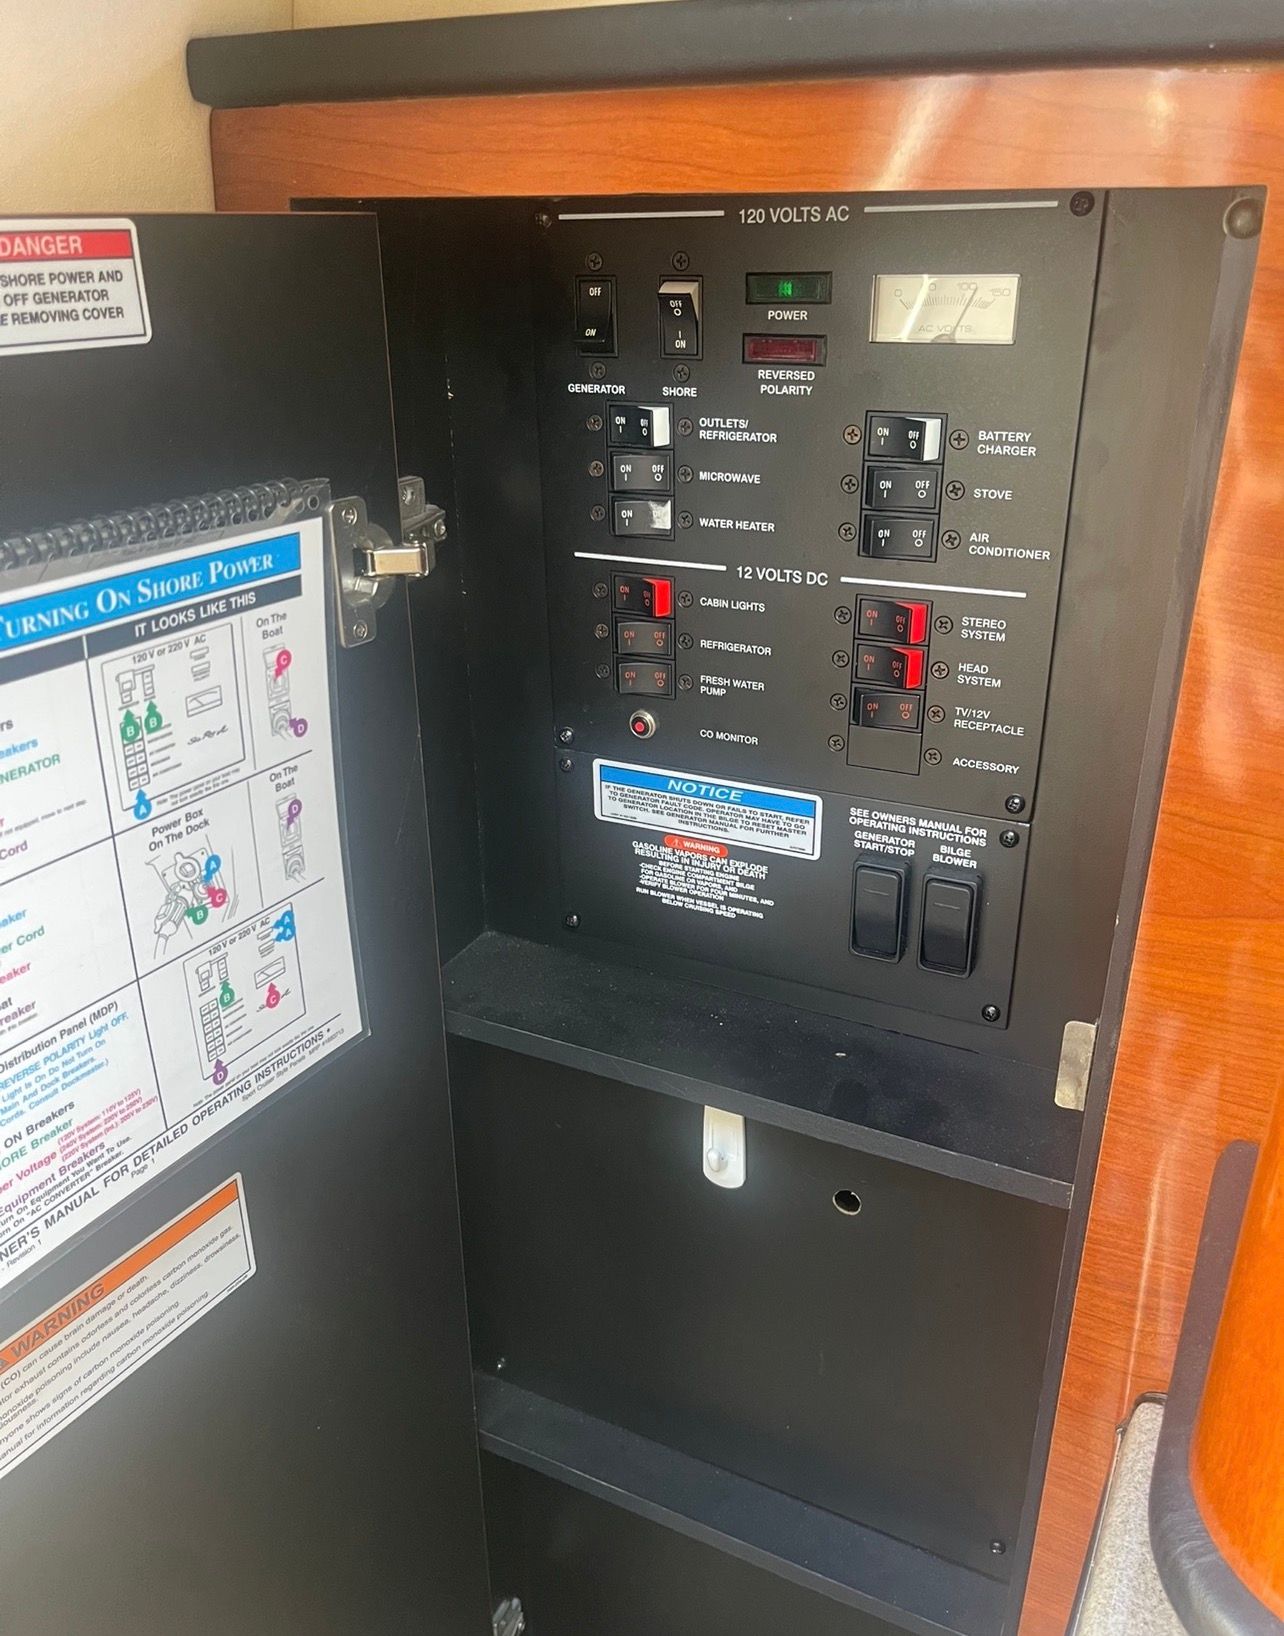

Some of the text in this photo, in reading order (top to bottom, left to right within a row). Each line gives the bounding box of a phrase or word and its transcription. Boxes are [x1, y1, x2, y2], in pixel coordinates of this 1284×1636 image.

[739, 206, 849, 224] 120 VOLTS AC
[0, 235, 83, 257] DANGER
[0, 270, 123, 287] SHORE POWER AND
[4, 289, 109, 306] OFF GENERATOR
[589, 287, 601, 296] OFF
[670, 300, 682, 308] OFF
[12, 311, 79, 325] REMOVING
[83, 307, 124, 320] COVER
[768, 310, 807, 321] POWER
[585, 329, 596, 337] ON
[675, 339, 686, 349] ON
[758, 370, 815, 381] REVERSED
[568, 383, 625, 394] GENERATOR
[662, 387, 697, 397] SHORE
[760, 385, 813, 395] POLARITY
[616, 417, 626, 425] ON
[700, 418, 748, 428] OUTLETS/
[700, 430, 777, 443] REFRIGERATOR
[877, 428, 919, 440] ON OFF
[979, 431, 1031, 442] BATTERY
[977, 444, 1036, 456] CHARGER
[620, 465, 664, 473] ON OFF
[700, 471, 761, 484] MICROWAVE
[880, 481, 929, 489] ON OFF
[973, 489, 1012, 500] STOVE
[622, 510, 632, 518] ON
[700, 518, 775, 532] WATER HEATER
[878, 530, 926, 538] ON OFF
[970, 533, 989, 542] AIR
[969, 546, 1050, 560] CONDITIONER
[737, 566, 828, 586] 12 VOLTS DC
[700, 597, 765, 612] CABIN LIGHTS
[135, 592, 257, 638] IT LOOKS LIKE THIS
[256, 613, 287, 628] On The
[867, 610, 905, 624] ON OFF
[962, 616, 1006, 630] STEREO
[262, 626, 284, 640] Boat
[961, 629, 1005, 642] SYSTEM
[132, 654, 147, 664] 120
[157, 648, 166, 656] or
[168, 641, 183, 653] 220
[194, 634, 206, 645] AC
[700, 640, 772, 656] REFRIGERATOR
[864, 655, 874, 663] ON
[959, 663, 988, 674] HEAD
[700, 675, 764, 691] FRESH WATER
[957, 675, 1001, 688] SYSTEM
[700, 686, 726, 696] PUMP
[867, 703, 912, 711] ON OFF
[955, 707, 990, 719] TV/12V
[954, 719, 1024, 736] RECEPTACLE
[700, 729, 758, 745] CO MONITOR
[269, 765, 298, 782] On The
[953, 758, 1019, 774] ACCESSORY
[275, 777, 295, 792] Boat
[667, 779, 744, 802] NOTICE
[627, 788, 667, 799] GENERATOR
[669, 796, 691, 804] SHUTS
[693, 800, 714, 808] DOWN
[728, 804, 747, 814] FAILS
[786, 816, 809, 824] REFER
[151, 808, 204, 837] Power Box
[850, 808, 987, 837] SEE OWNERS MANUAL FOR
[149, 818, 210, 851] On The Dock
[849, 816, 987, 847] OPERATING INSTRUCTIONS
[854, 831, 915, 848] GENERATOR
[683, 841, 720, 854] WARNING
[854, 840, 915, 857] START/STOP
[940, 845, 971, 858] BILGE
[632, 841, 768, 873] GASOLINE VAPORS CAN EXPLODE
[635, 848, 679, 862] RESULTING
[692, 859, 721, 870] INJURY
[737, 868, 766, 880] DEATH
[933, 854, 977, 869] BLOWER
[60, 1018, 87, 1039] Panel
[90, 1001, 118, 1024] (MDP)
[4, 1101, 75, 1148] ON Breakers
[44, 1187, 100, 1229] MANUAL
[103, 1165, 129, 1188] FOR
[133, 1123, 188, 1166] DETAILED
[192, 1080, 252, 1126] OPERATING
[254, 1031, 324, 1084] INSTRUCTIONS
[31, 1119, 73, 1149] Breaker
[16, 1152, 57, 1180] Voltage
[59, 1142, 105, 1177] Breakers
[131, 1164, 149, 1179] Page
[11, 1283, 105, 1359] WARNING
[0, 1372, 21, 1389] (CO)
[22, 1360, 38, 1372] can
[39, 1338, 63, 1360] cause
[63, 1322, 85, 1341] brain
[85, 1300, 116, 1325] damage
[117, 1293, 125, 1302] or
